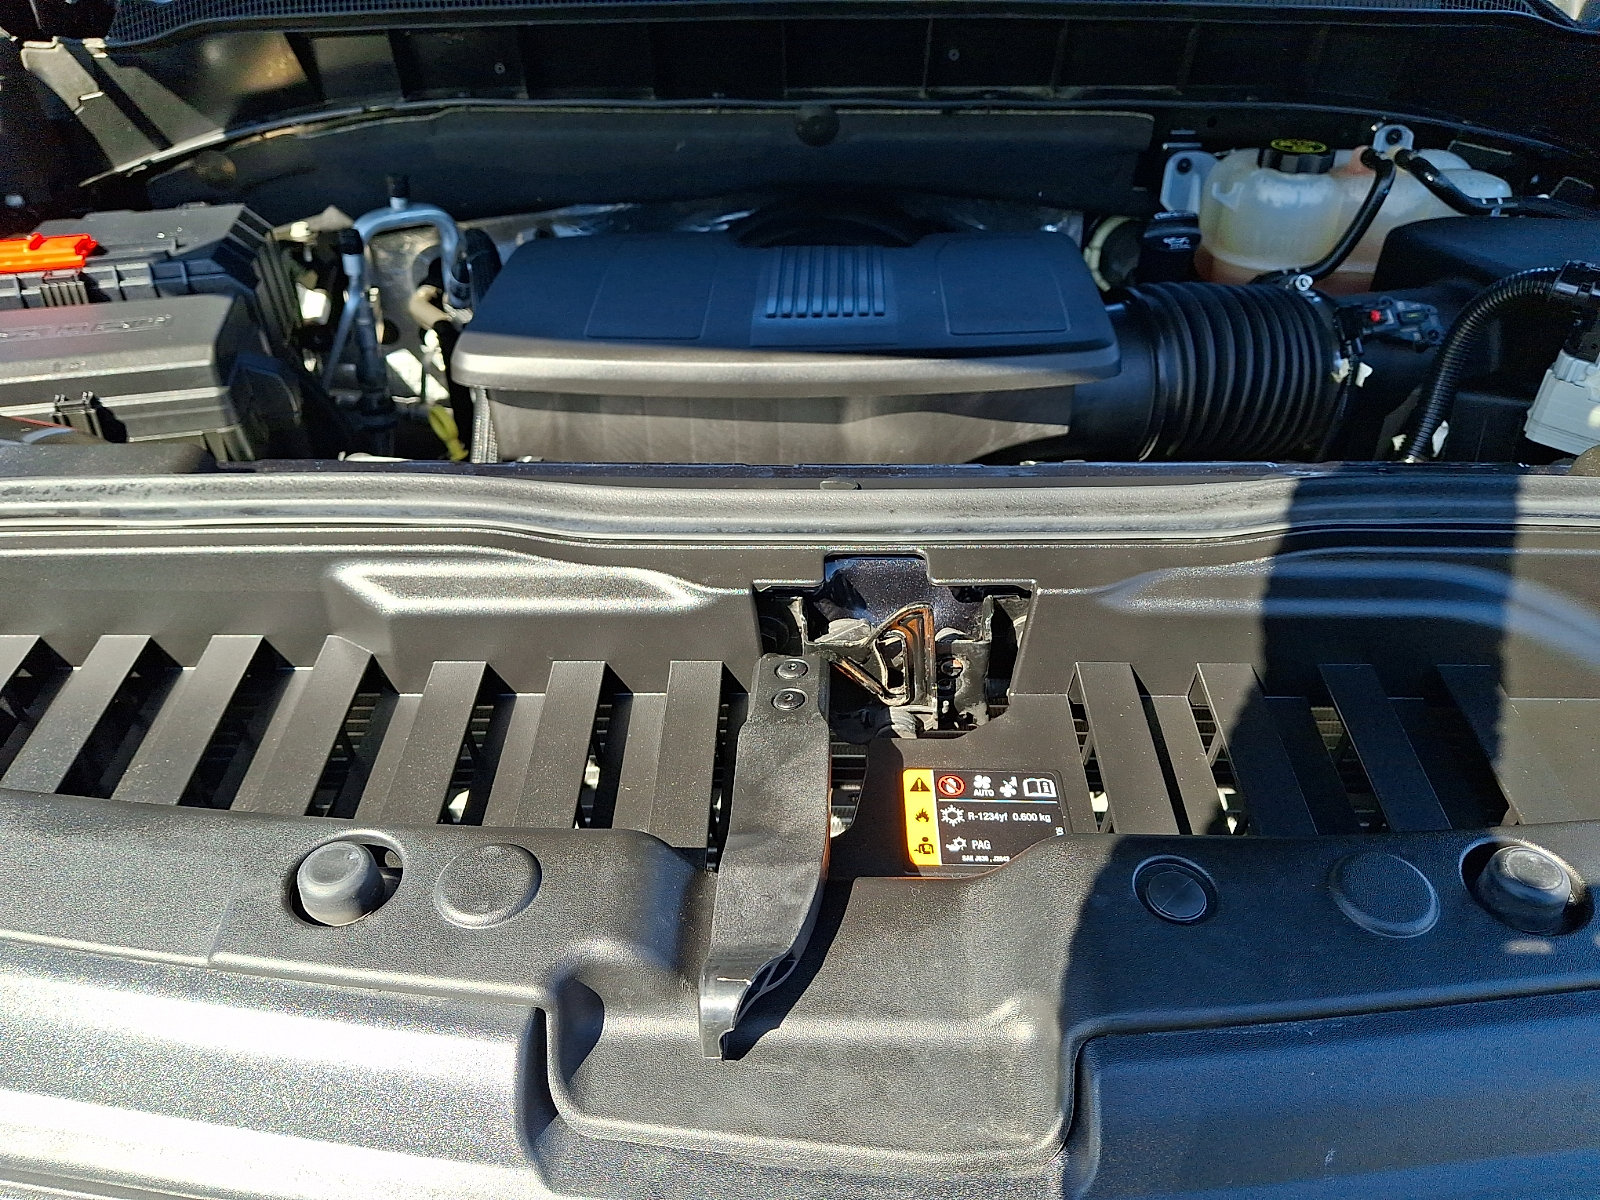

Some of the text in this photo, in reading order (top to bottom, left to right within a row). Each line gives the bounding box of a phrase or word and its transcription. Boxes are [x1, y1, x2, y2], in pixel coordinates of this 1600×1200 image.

[973, 789, 995, 797] AUTO
[967, 812, 1052, 823] R-1234yf 0.600 kg
[971, 839, 992, 850] PAG
